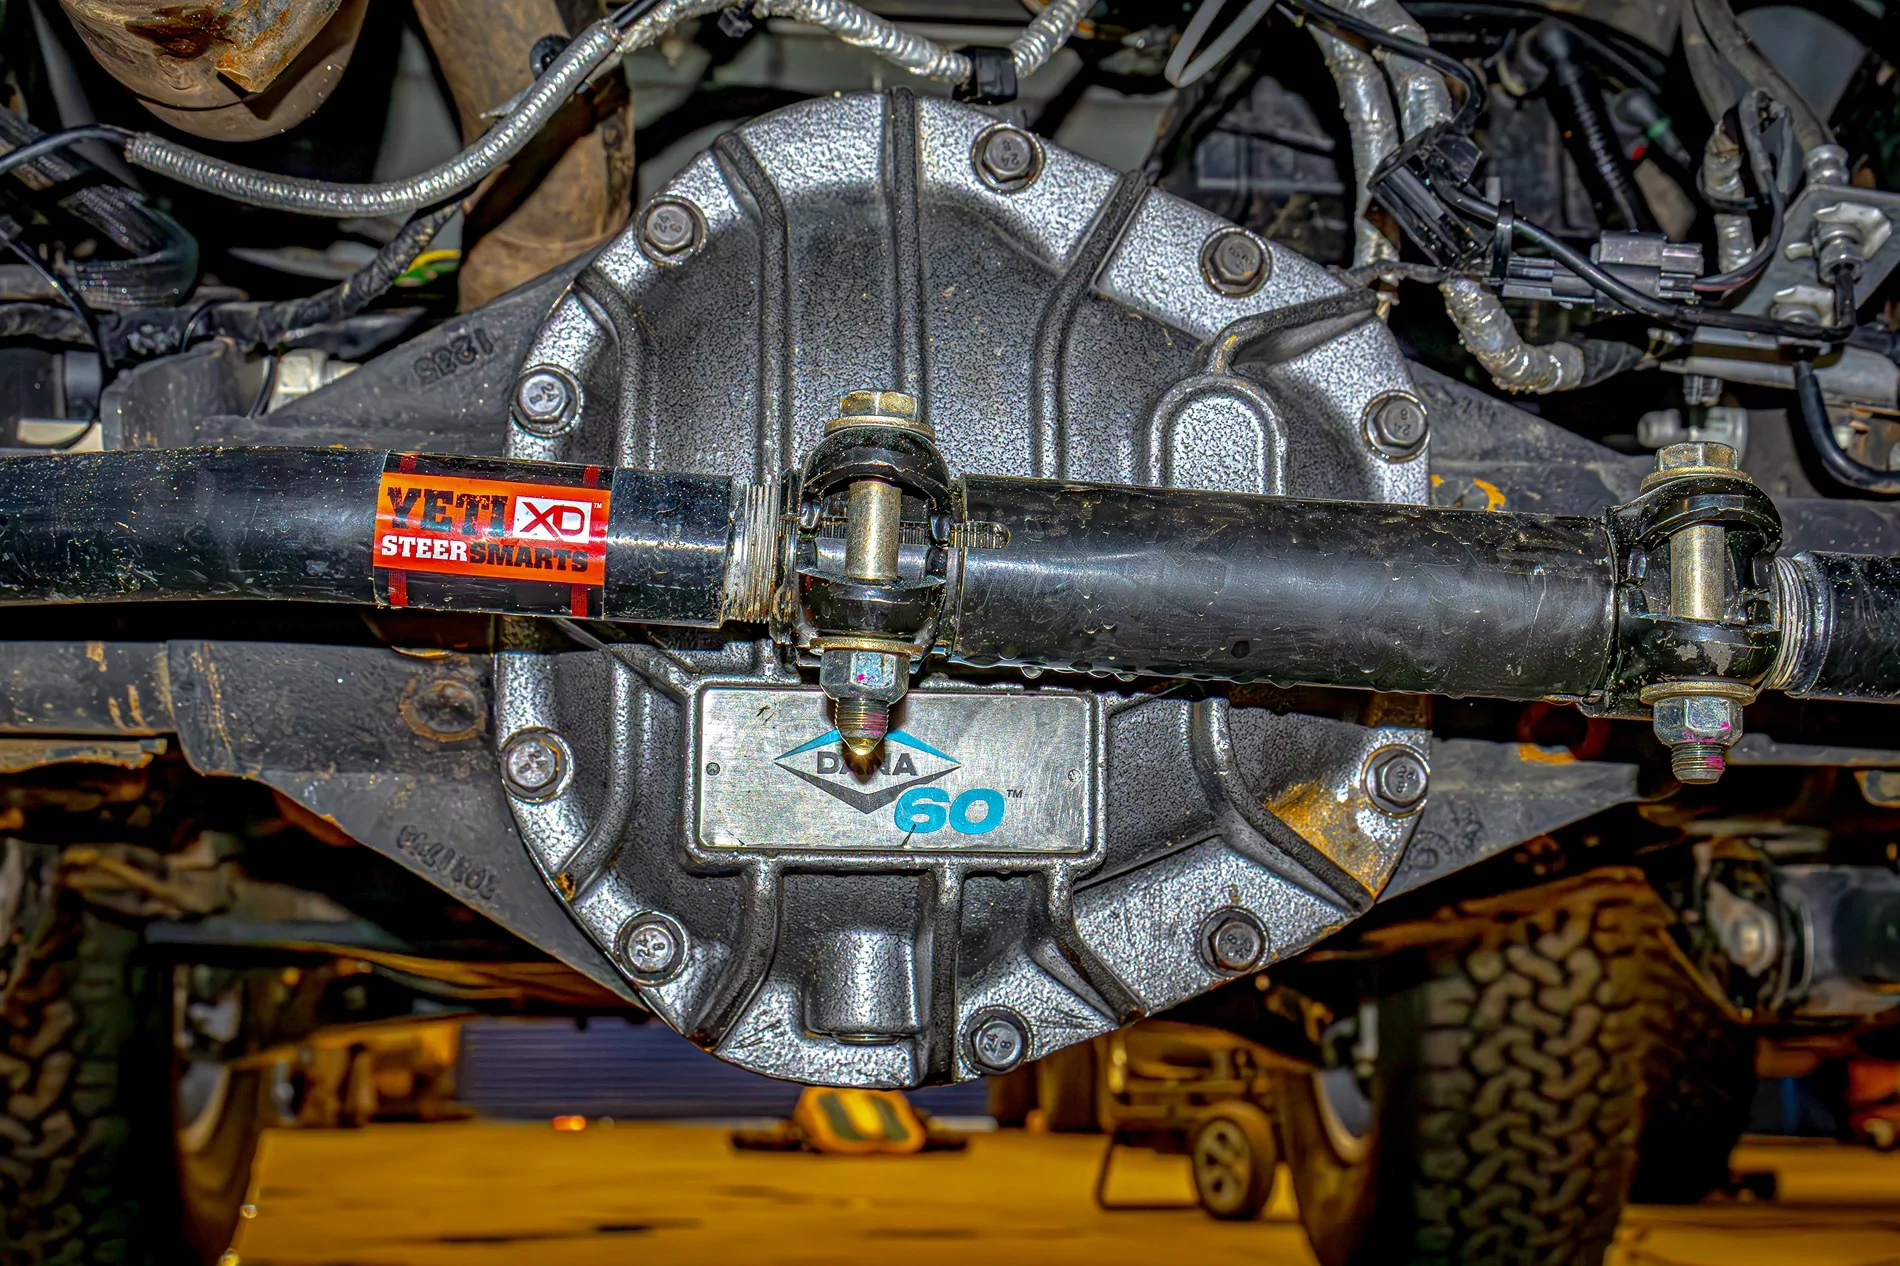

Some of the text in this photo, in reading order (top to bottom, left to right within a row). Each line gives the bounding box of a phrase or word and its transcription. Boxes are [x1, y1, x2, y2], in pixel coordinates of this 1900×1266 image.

[387, 486, 508, 538] YETI
[519, 501, 585, 542] XD
[381, 534, 589, 573] STEER SMARTS
[893, 786, 1006, 835] 60
